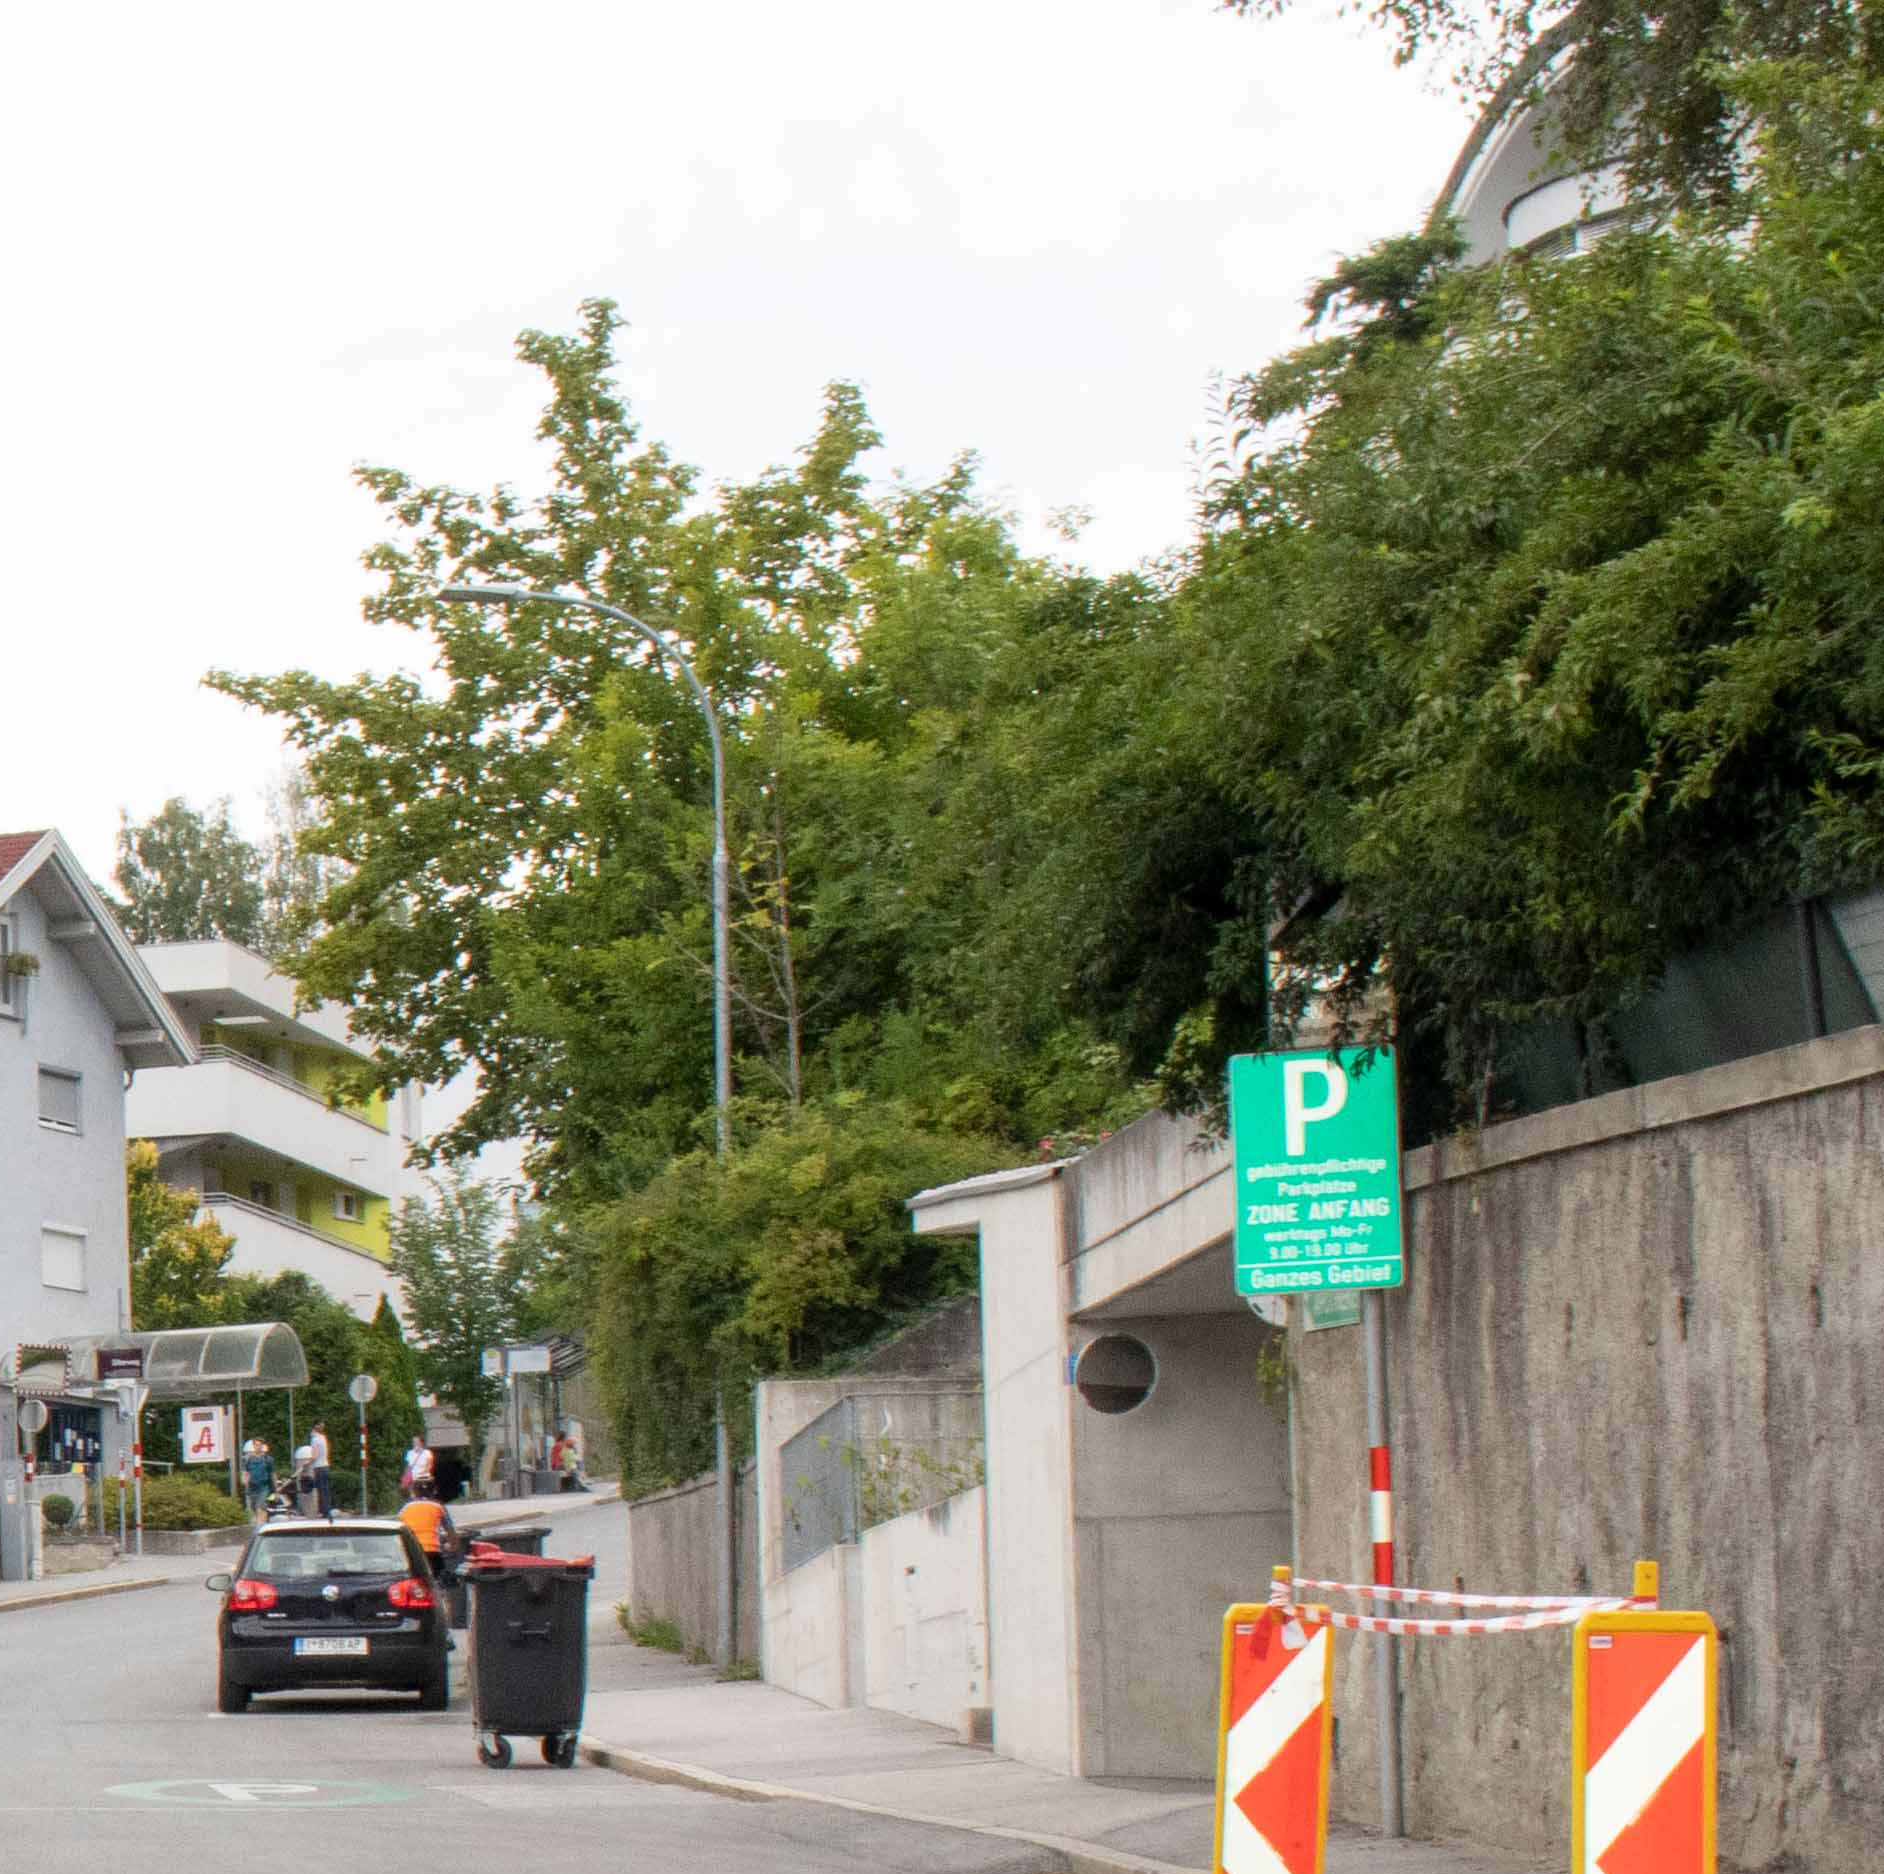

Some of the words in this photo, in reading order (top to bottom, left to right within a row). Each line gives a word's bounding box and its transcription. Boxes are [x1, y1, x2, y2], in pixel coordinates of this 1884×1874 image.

[1283, 1058, 1349, 1156] P
[1246, 1203, 1300, 1226] ZONE
[1308, 1197, 1391, 1221] ANFANG
[1345, 1242, 1369, 1255] Uhr
[1250, 1268, 1323, 1289] Ganzes
[1327, 1263, 1392, 1284] Gebiet
[191, 1426, 215, 1454] A
